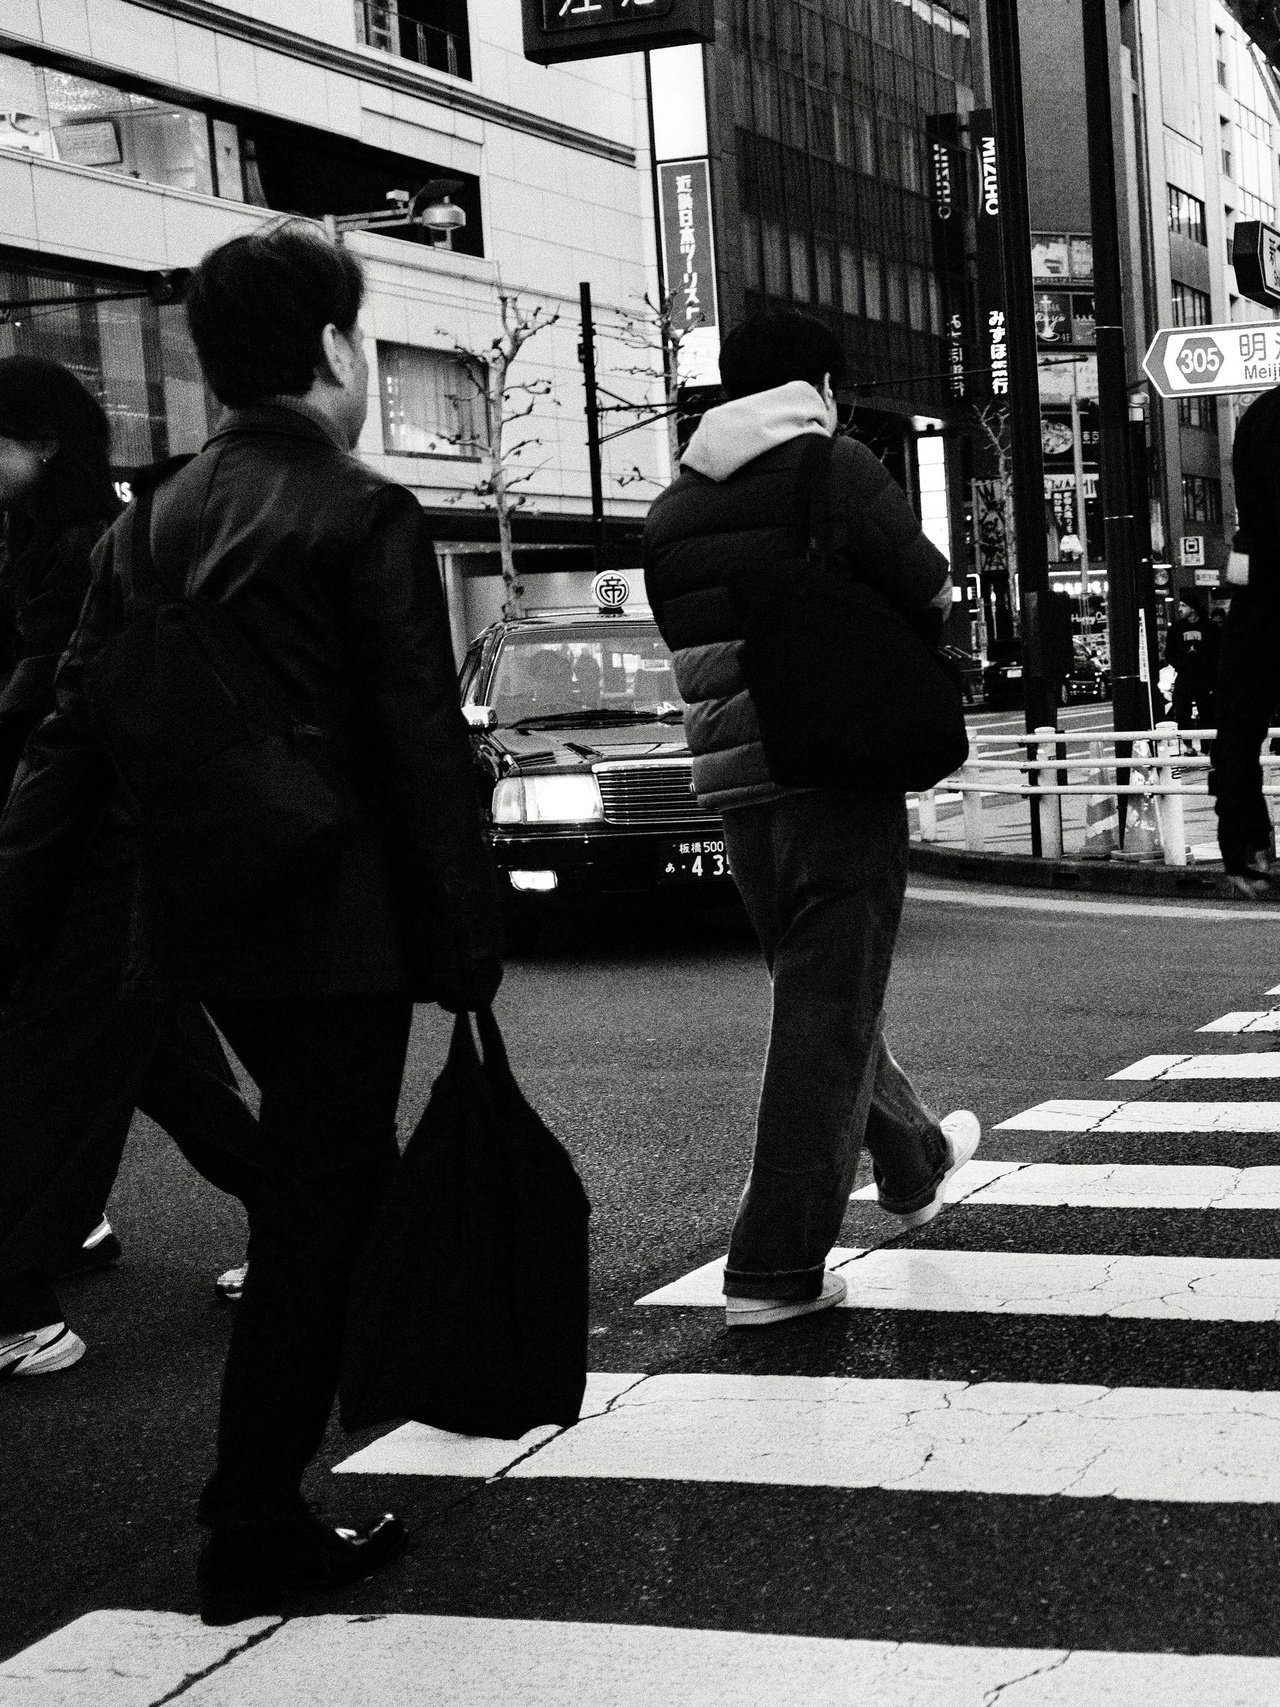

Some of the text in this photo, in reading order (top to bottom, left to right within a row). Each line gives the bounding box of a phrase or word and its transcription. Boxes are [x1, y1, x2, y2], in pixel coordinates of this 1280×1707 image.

[982, 137, 999, 216] MIZUHO
[989, 310, 1009, 395] みずほ銀行
[1180, 347, 1220, 374] 305
[664, 862, 675, 873] あ
